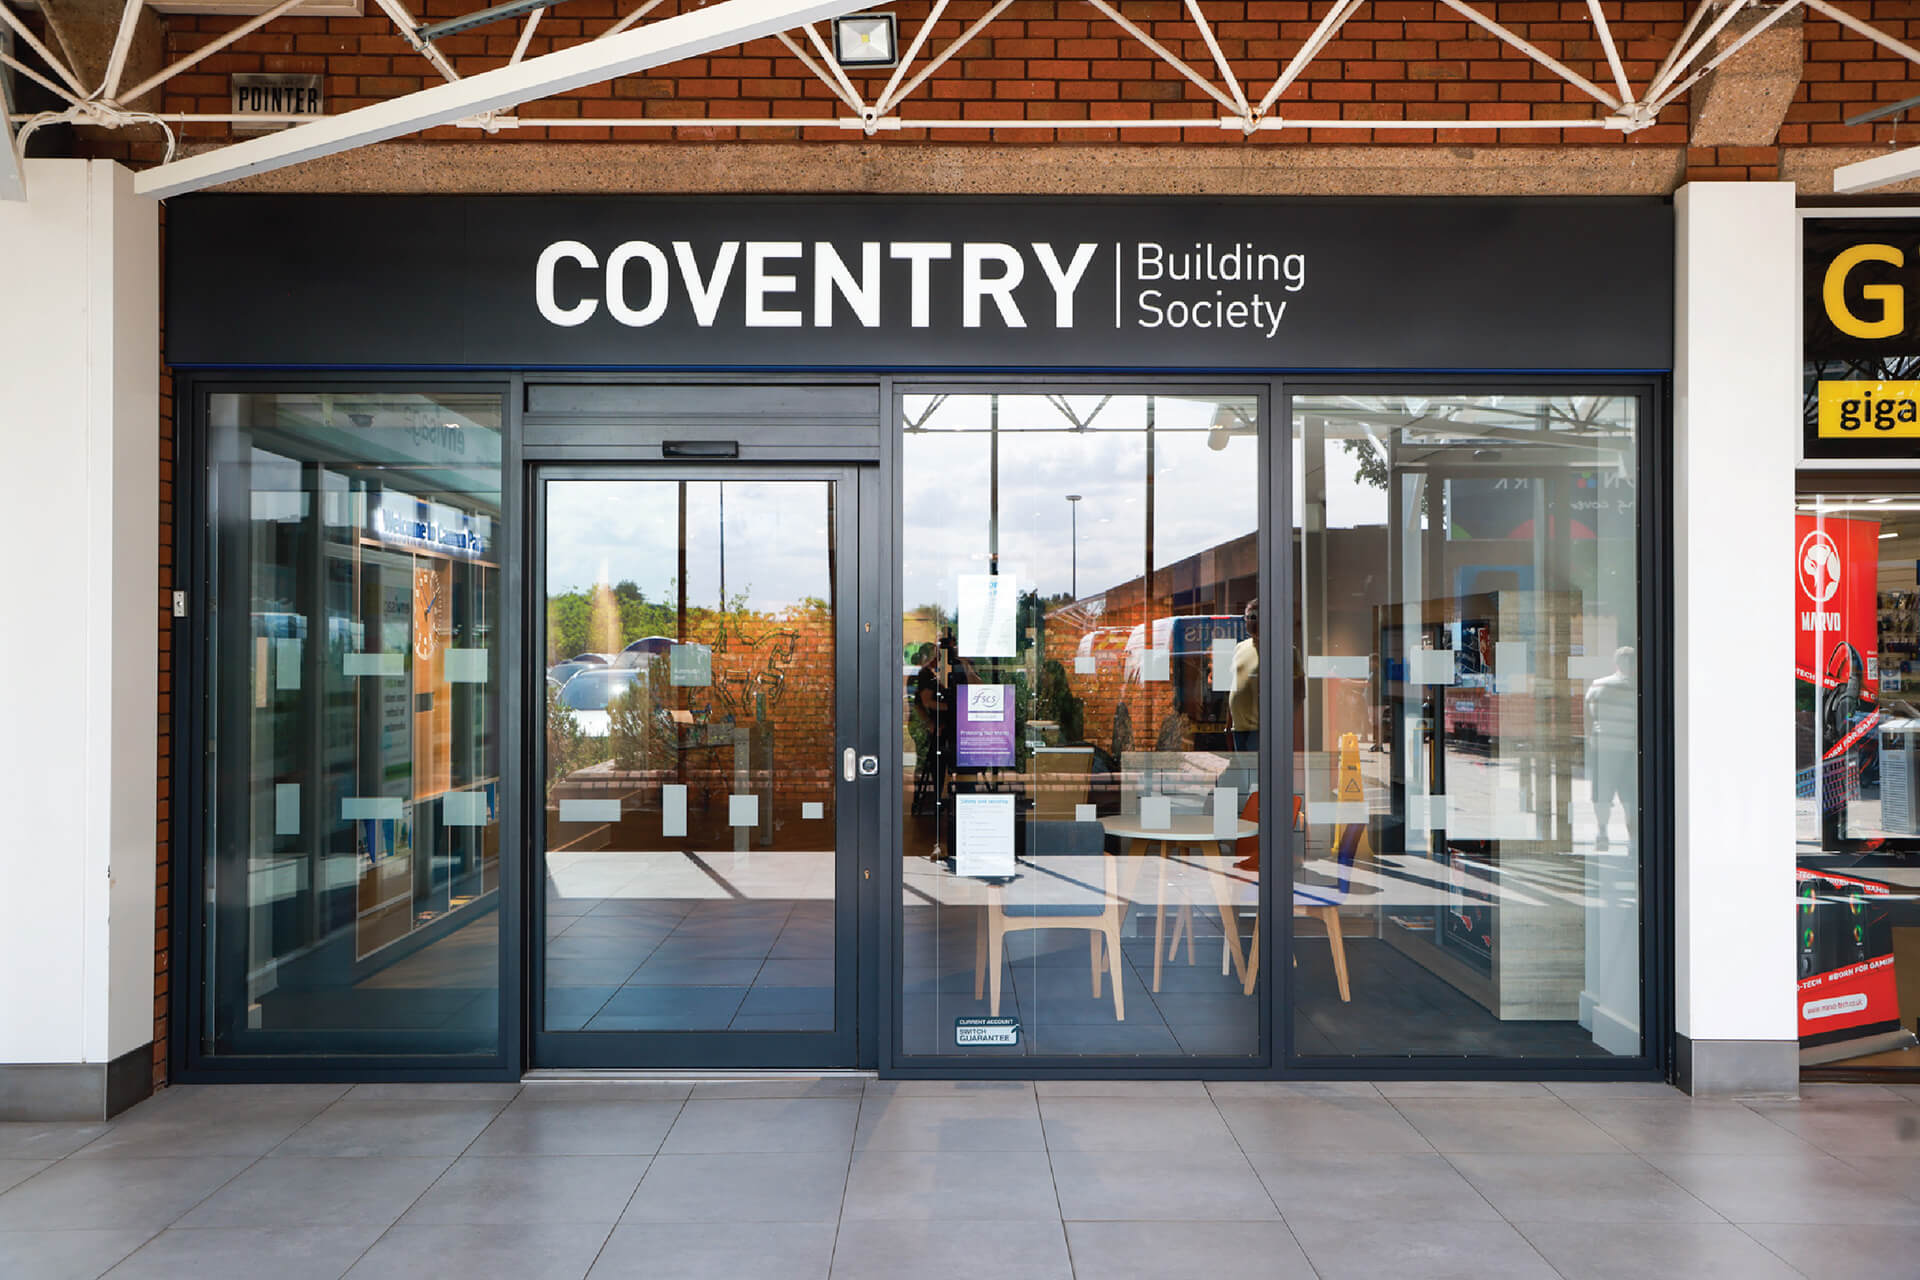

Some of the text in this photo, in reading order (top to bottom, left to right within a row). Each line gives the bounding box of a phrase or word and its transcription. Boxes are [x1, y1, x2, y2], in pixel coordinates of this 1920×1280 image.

[239, 87, 318, 113] POINTER
[535, 240, 1098, 328] COVENTRY
[1138, 243, 1305, 291] Building
[1823, 243, 1920, 339] G
[1138, 289, 1287, 339] Society
[1840, 391, 1917, 430] giga
[1801, 612, 1841, 631] MARVO
[1854, 963, 1869, 974] FOR
[959, 1034, 1010, 1042] GUARANTEE
